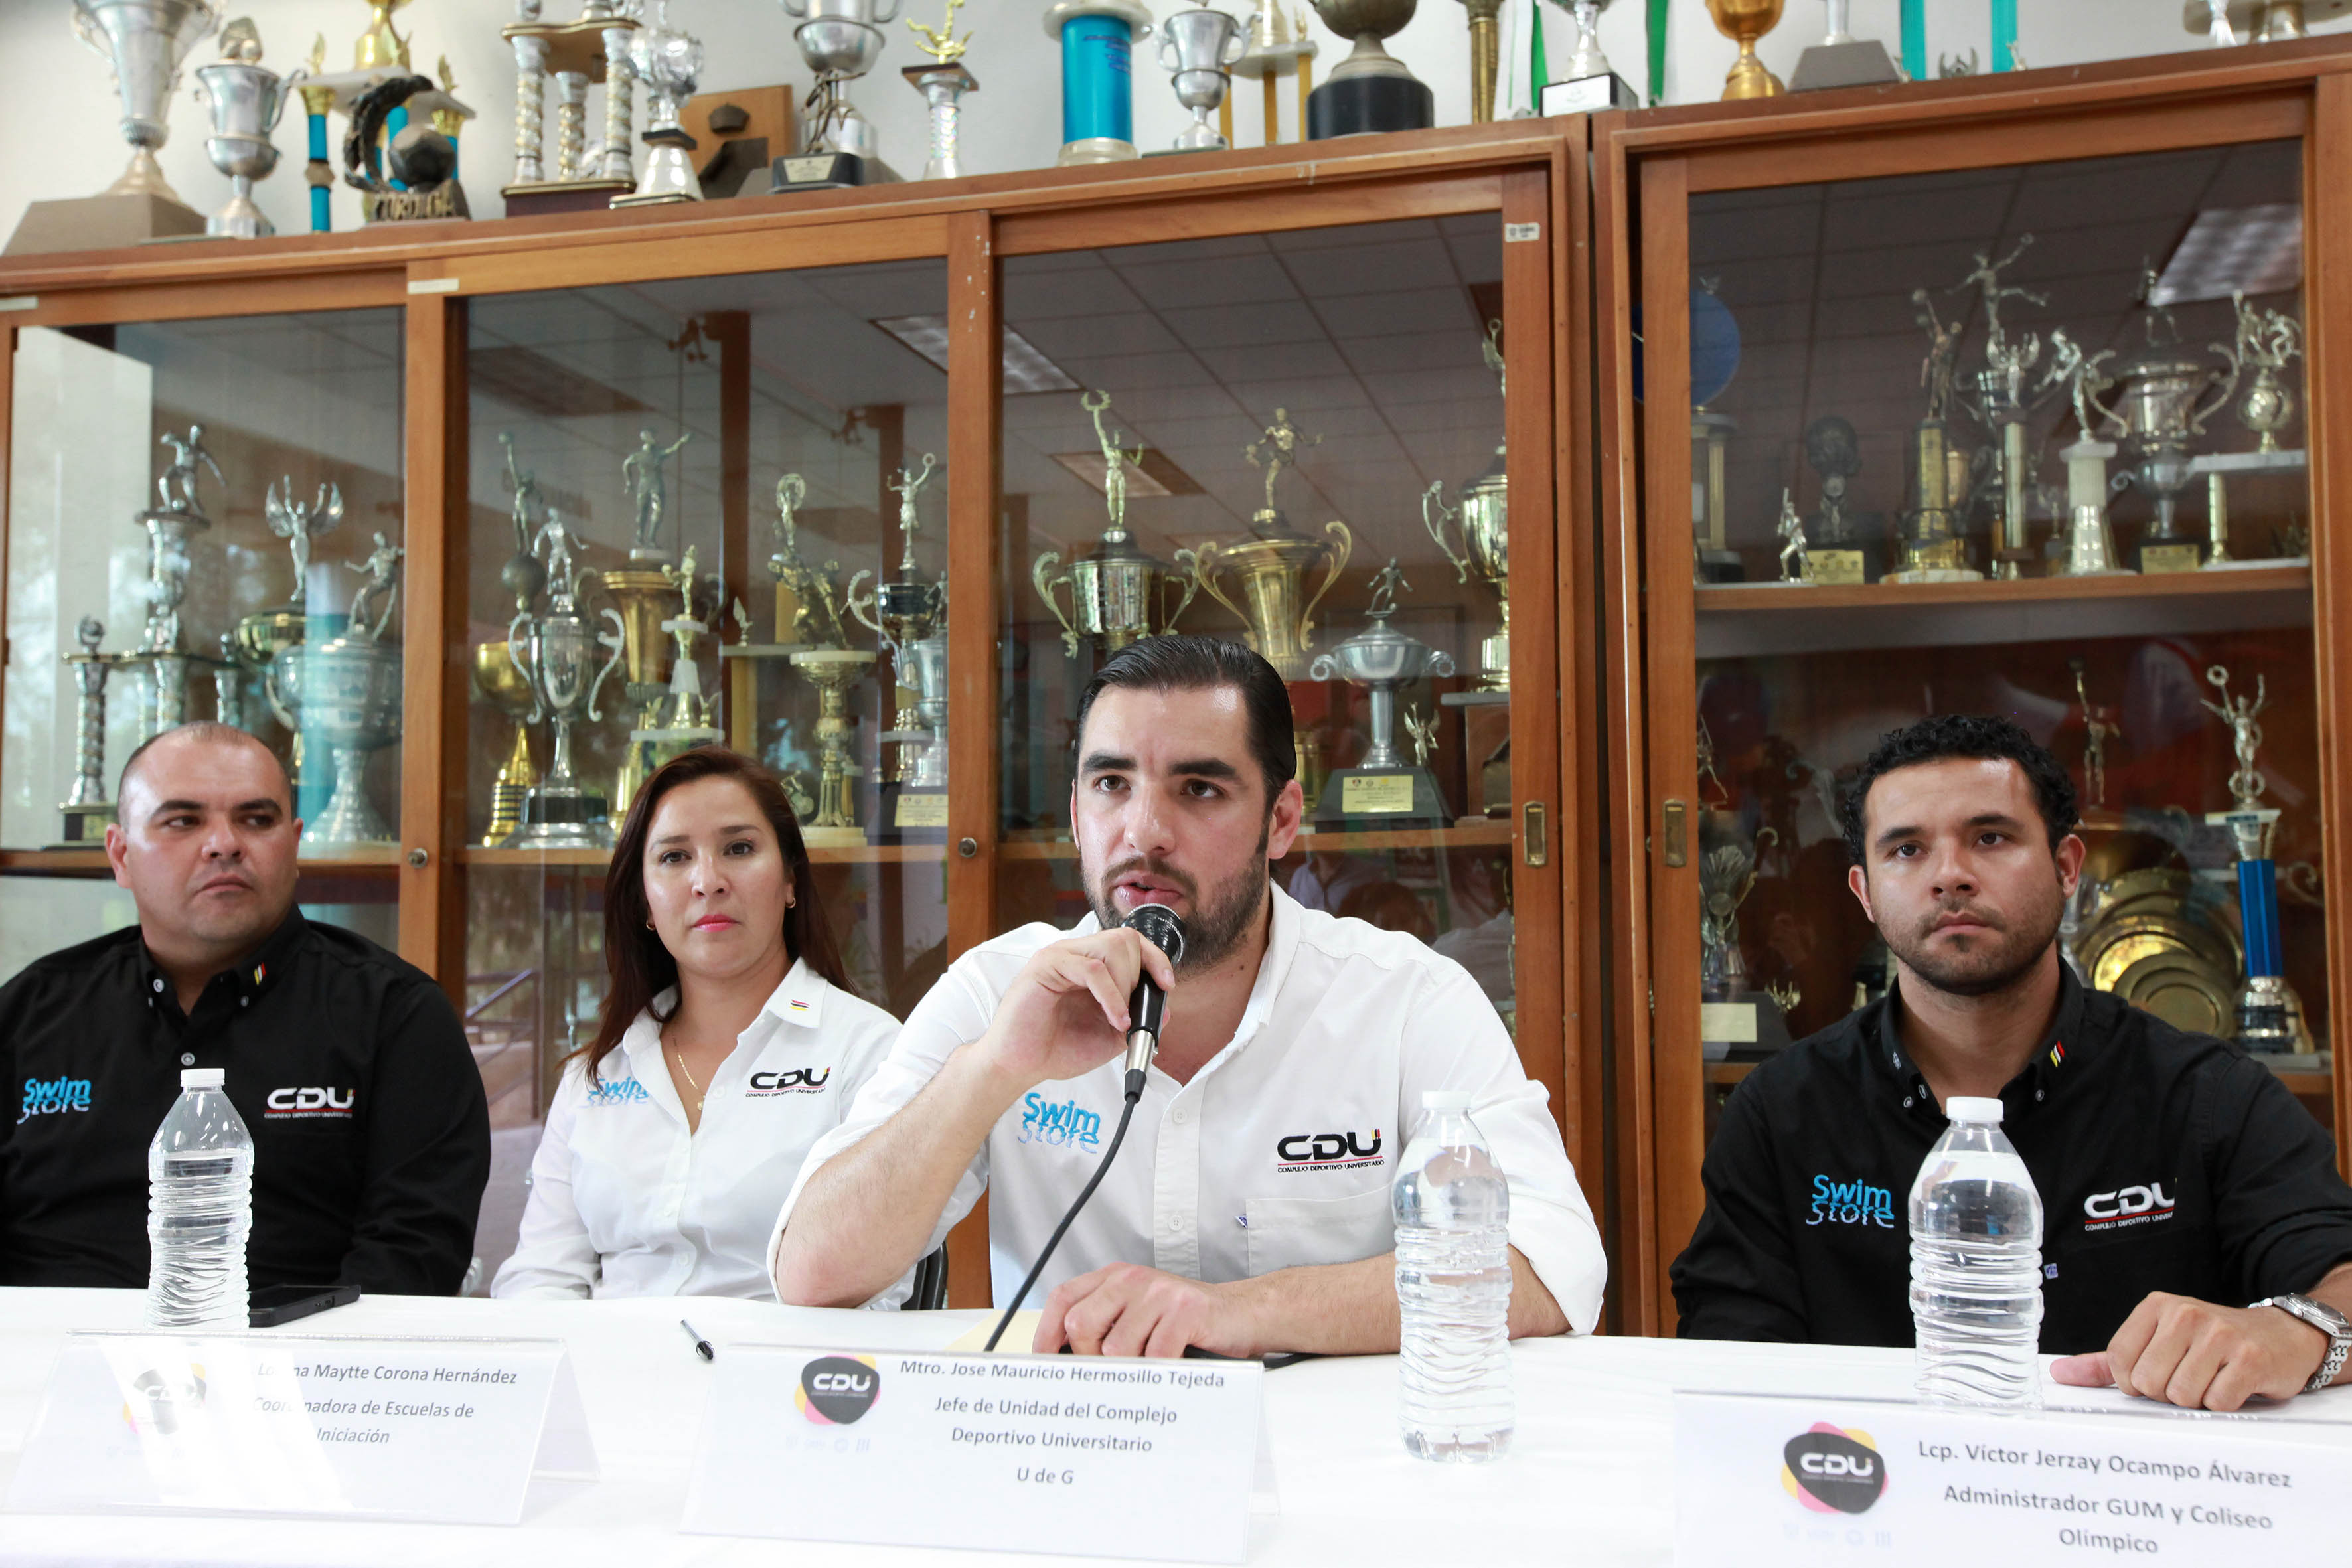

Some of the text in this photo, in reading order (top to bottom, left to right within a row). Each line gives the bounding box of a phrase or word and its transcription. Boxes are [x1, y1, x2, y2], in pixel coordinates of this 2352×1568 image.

[23, 1076, 92, 1103] Swim
[750, 1067, 831, 1090] CDU
[266, 1087, 356, 1110] CDU
[1022, 1092, 1101, 1133] Swim
[1277, 1129, 1382, 1161] CDU
[1344, 1159, 1385, 1170] UNIVERSITARIO
[1812, 1174, 1892, 1211] Swim
[258, 1362, 518, 1384] Lona Maytte Corona Hernández
[812, 1372, 872, 1393] CDU
[900, 1360, 1225, 1389] Mtro. Jose Mauricio Hermosillo Tejeda
[255, 1397, 475, 1419] Coornadora de Escuelas de
[934, 1396, 1178, 1426] Jefe de Unidad del Complejo
[317, 1427, 390, 1444] Iniciación
[951, 1427, 1152, 1452] Deportivo Universitario
[1016, 1467, 1074, 1485] U de G
[1800, 1452, 1874, 1477] CDU
[1919, 1440, 1959, 1462] Lcp.
[2035, 1449, 2102, 1475] Jerzay
[2108, 1454, 2201, 1482] Ocampo
[2208, 1460, 2292, 1488] Álvarez
[1944, 1484, 2274, 1530] Administrador GUM y Coliseo
